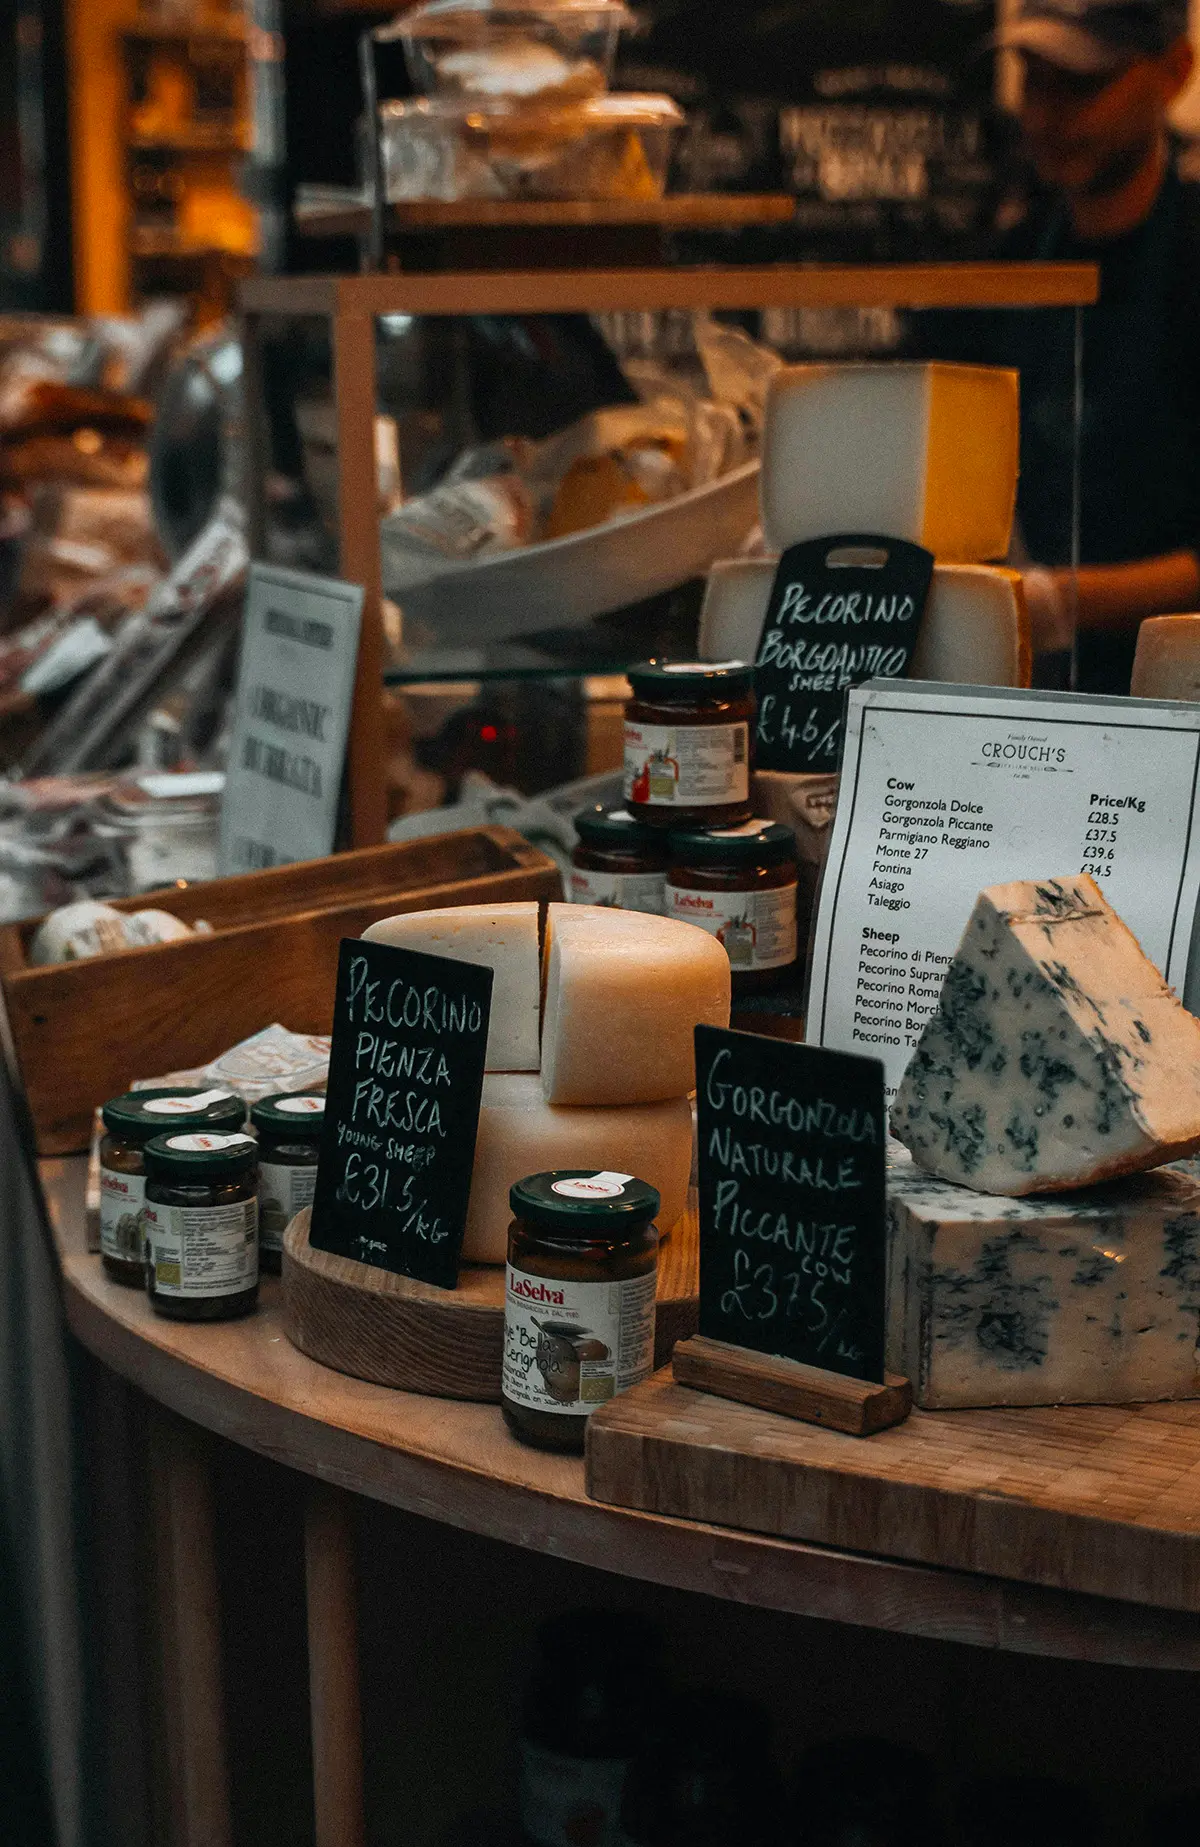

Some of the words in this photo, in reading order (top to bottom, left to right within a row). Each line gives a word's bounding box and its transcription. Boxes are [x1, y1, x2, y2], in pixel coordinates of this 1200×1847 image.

[776, 582, 914, 624] PECORINO
[789, 672, 852, 691] SHEEP
[981, 742, 1066, 763] CROUCH'S
[886, 777, 915, 791] Cow
[884, 794, 947, 811] Gorgonzola
[950, 799, 984, 814] Dolce
[1089, 793, 1146, 813] Price/Kg
[882, 811, 944, 828] Gorgonzola
[948, 817, 994, 832] Piccante
[1087, 811, 1119, 825] £28.5
[879, 828, 938, 845] Parmigiano
[941, 833, 990, 850] Reggiano
[1085, 828, 1117, 842] £37.5
[875, 844, 911, 858] Monte
[914, 848, 928, 859] 27
[1082, 846, 1115, 859] £39.6
[872, 860, 912, 875] Fontina
[868, 877, 905, 893] Asiago
[867, 893, 911, 911] Taleggio
[861, 927, 900, 944] Sheep
[860, 944, 908, 960] Pecorino
[911, 950, 922, 961] di
[858, 961, 906, 977] Pecorino
[346, 955, 481, 1035] PECORINO
[857, 978, 904, 994] Pecorino
[908, 984, 941, 998] Roma
[855, 995, 903, 1011] Pecorino
[854, 1012, 902, 1028] Pecorino
[852, 1028, 901, 1046] Pecorino
[904, 1034, 920, 1047] Ta
[356, 1031, 451, 1087] PIENZA
[706, 1049, 877, 1144] GORGONZOLA
[351, 1077, 447, 1138] FRESCA
[337, 1120, 384, 1151] YOUNG
[709, 1127, 862, 1191] NATURALE
[712, 1180, 857, 1264] PICCANTE
[802, 1254, 851, 1285] COW
[510, 1272, 565, 1304] LaSelva
